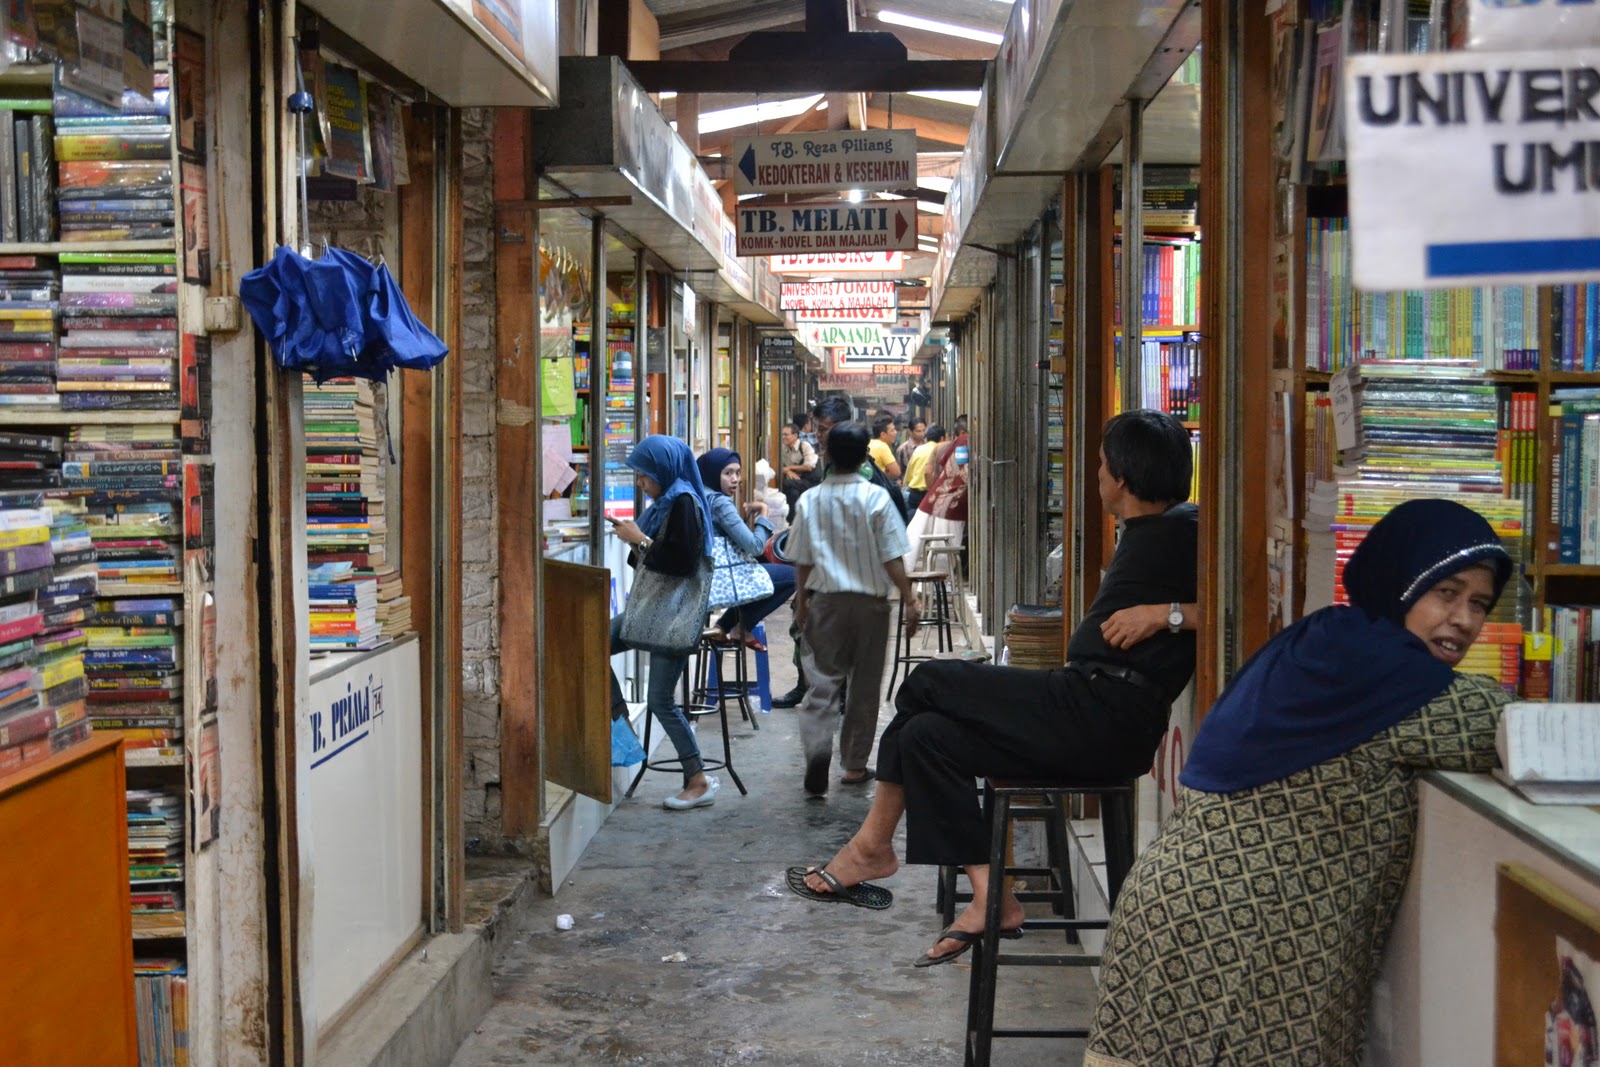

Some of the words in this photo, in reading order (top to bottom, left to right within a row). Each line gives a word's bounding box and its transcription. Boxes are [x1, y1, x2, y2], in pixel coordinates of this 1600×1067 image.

[771, 142, 798, 159] TB.
[803, 140, 837, 157] Reza
[842, 138, 893, 155] Piliang
[758, 163, 830, 186] KEDOKTERAN
[834, 163, 842, 182] &
[846, 160, 910, 182] KESEHATAN
[741, 210, 785, 233] TB.
[792, 207, 888, 232] MELATI
[816, 235, 835, 247] DAN
[839, 233, 887, 247] MAJALAH
[781, 283, 833, 296] UNIVERSITAS
[844, 281, 894, 294] UMUM
[848, 296, 888, 308] MAJALAH
[821, 327, 880, 344] ARNANDA
[1552, 479, 1560, 524] KOMUNIKASI
[310, 711, 326, 753] B.
